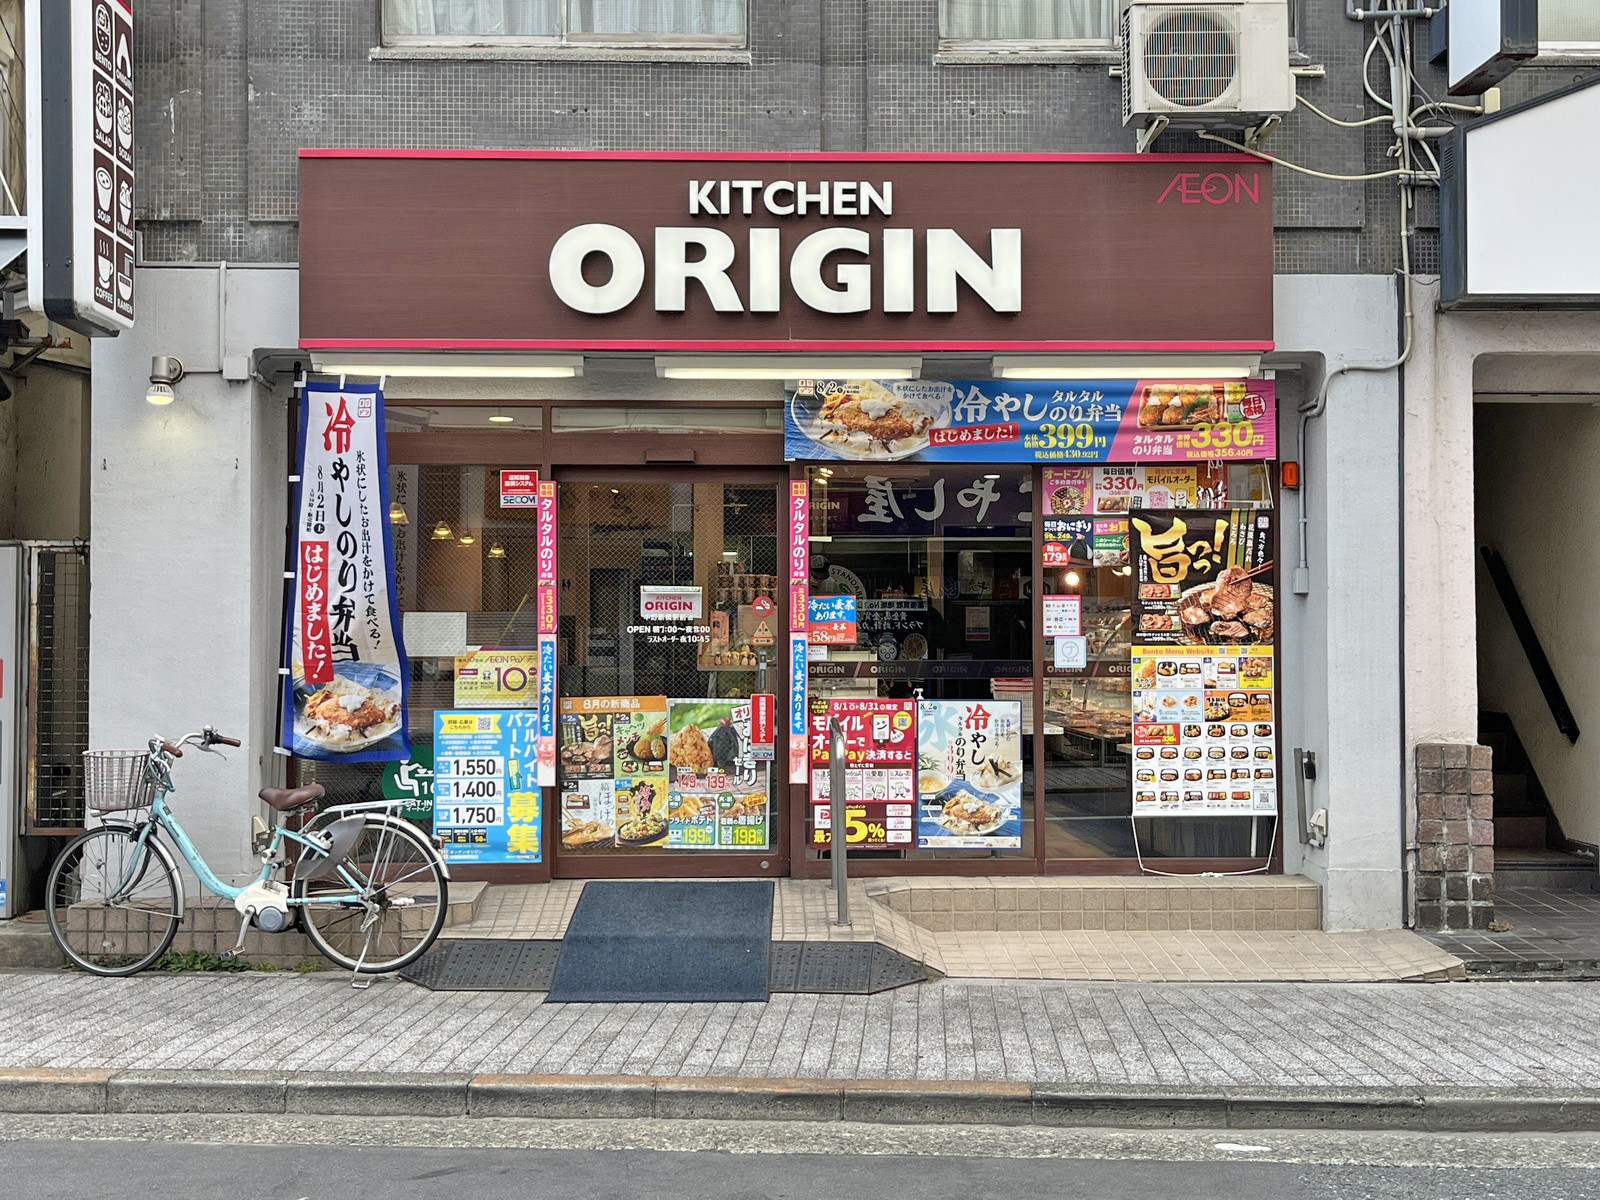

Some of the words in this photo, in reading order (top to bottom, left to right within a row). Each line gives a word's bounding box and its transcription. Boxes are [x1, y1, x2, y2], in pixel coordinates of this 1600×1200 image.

[95, 50, 112, 71] BENTO
[95, 129, 112, 148] SALAD
[688, 180, 893, 216] KITCHEN
[97, 209, 112, 225] SOUP
[547, 223, 1022, 315] ORIGIN
[95, 287, 113, 304] COFFEE
[117, 298, 133, 314] RAMEN
[896, 385, 952, 393] 氷状にしたお出汁を
[1051, 390, 1103, 403] タルタル
[954, 385, 1048, 424] 冷やし
[1049, 403, 1121, 422] のり弁当
[933, 425, 1014, 443] はじめました!
[1133, 434, 1174, 444] タルタル
[1133, 444, 1173, 456] のり弁当
[1044, 469, 1092, 479] オードブル
[1147, 475, 1196, 484] モバイルオーダー
[503, 495, 536, 504] SECOM
[808, 501, 841, 510] RIGIN
[1057, 520, 1092, 532] おにぎり
[305, 544, 328, 679] はじめました!
[644, 601, 693, 611] ORIGIN
[808, 599, 856, 611] 冷たい麦茶
[809, 665, 845, 674] ORIGIN
[870, 665, 906, 674] ORIGIN
[932, 665, 968, 674] ORIGIN
[994, 665, 1030, 674] ORIGIN
[495, 667, 528, 691] 10
[541, 643, 554, 734] 冷たい麦茶あります。
[792, 641, 806, 733] 冷たい麦茶あります。
[582, 699, 641, 709] 8月の新商品
[506, 712, 524, 758] パート
[616, 722, 645, 735] キャベツ
[965, 703, 992, 766] 冷やし
[617, 731, 639, 746] メンチ
[812, 731, 866, 750] オーで
[813, 749, 912, 764] Paay決済すると
[733, 757, 743, 786] セール
[507, 791, 540, 854] 募集
